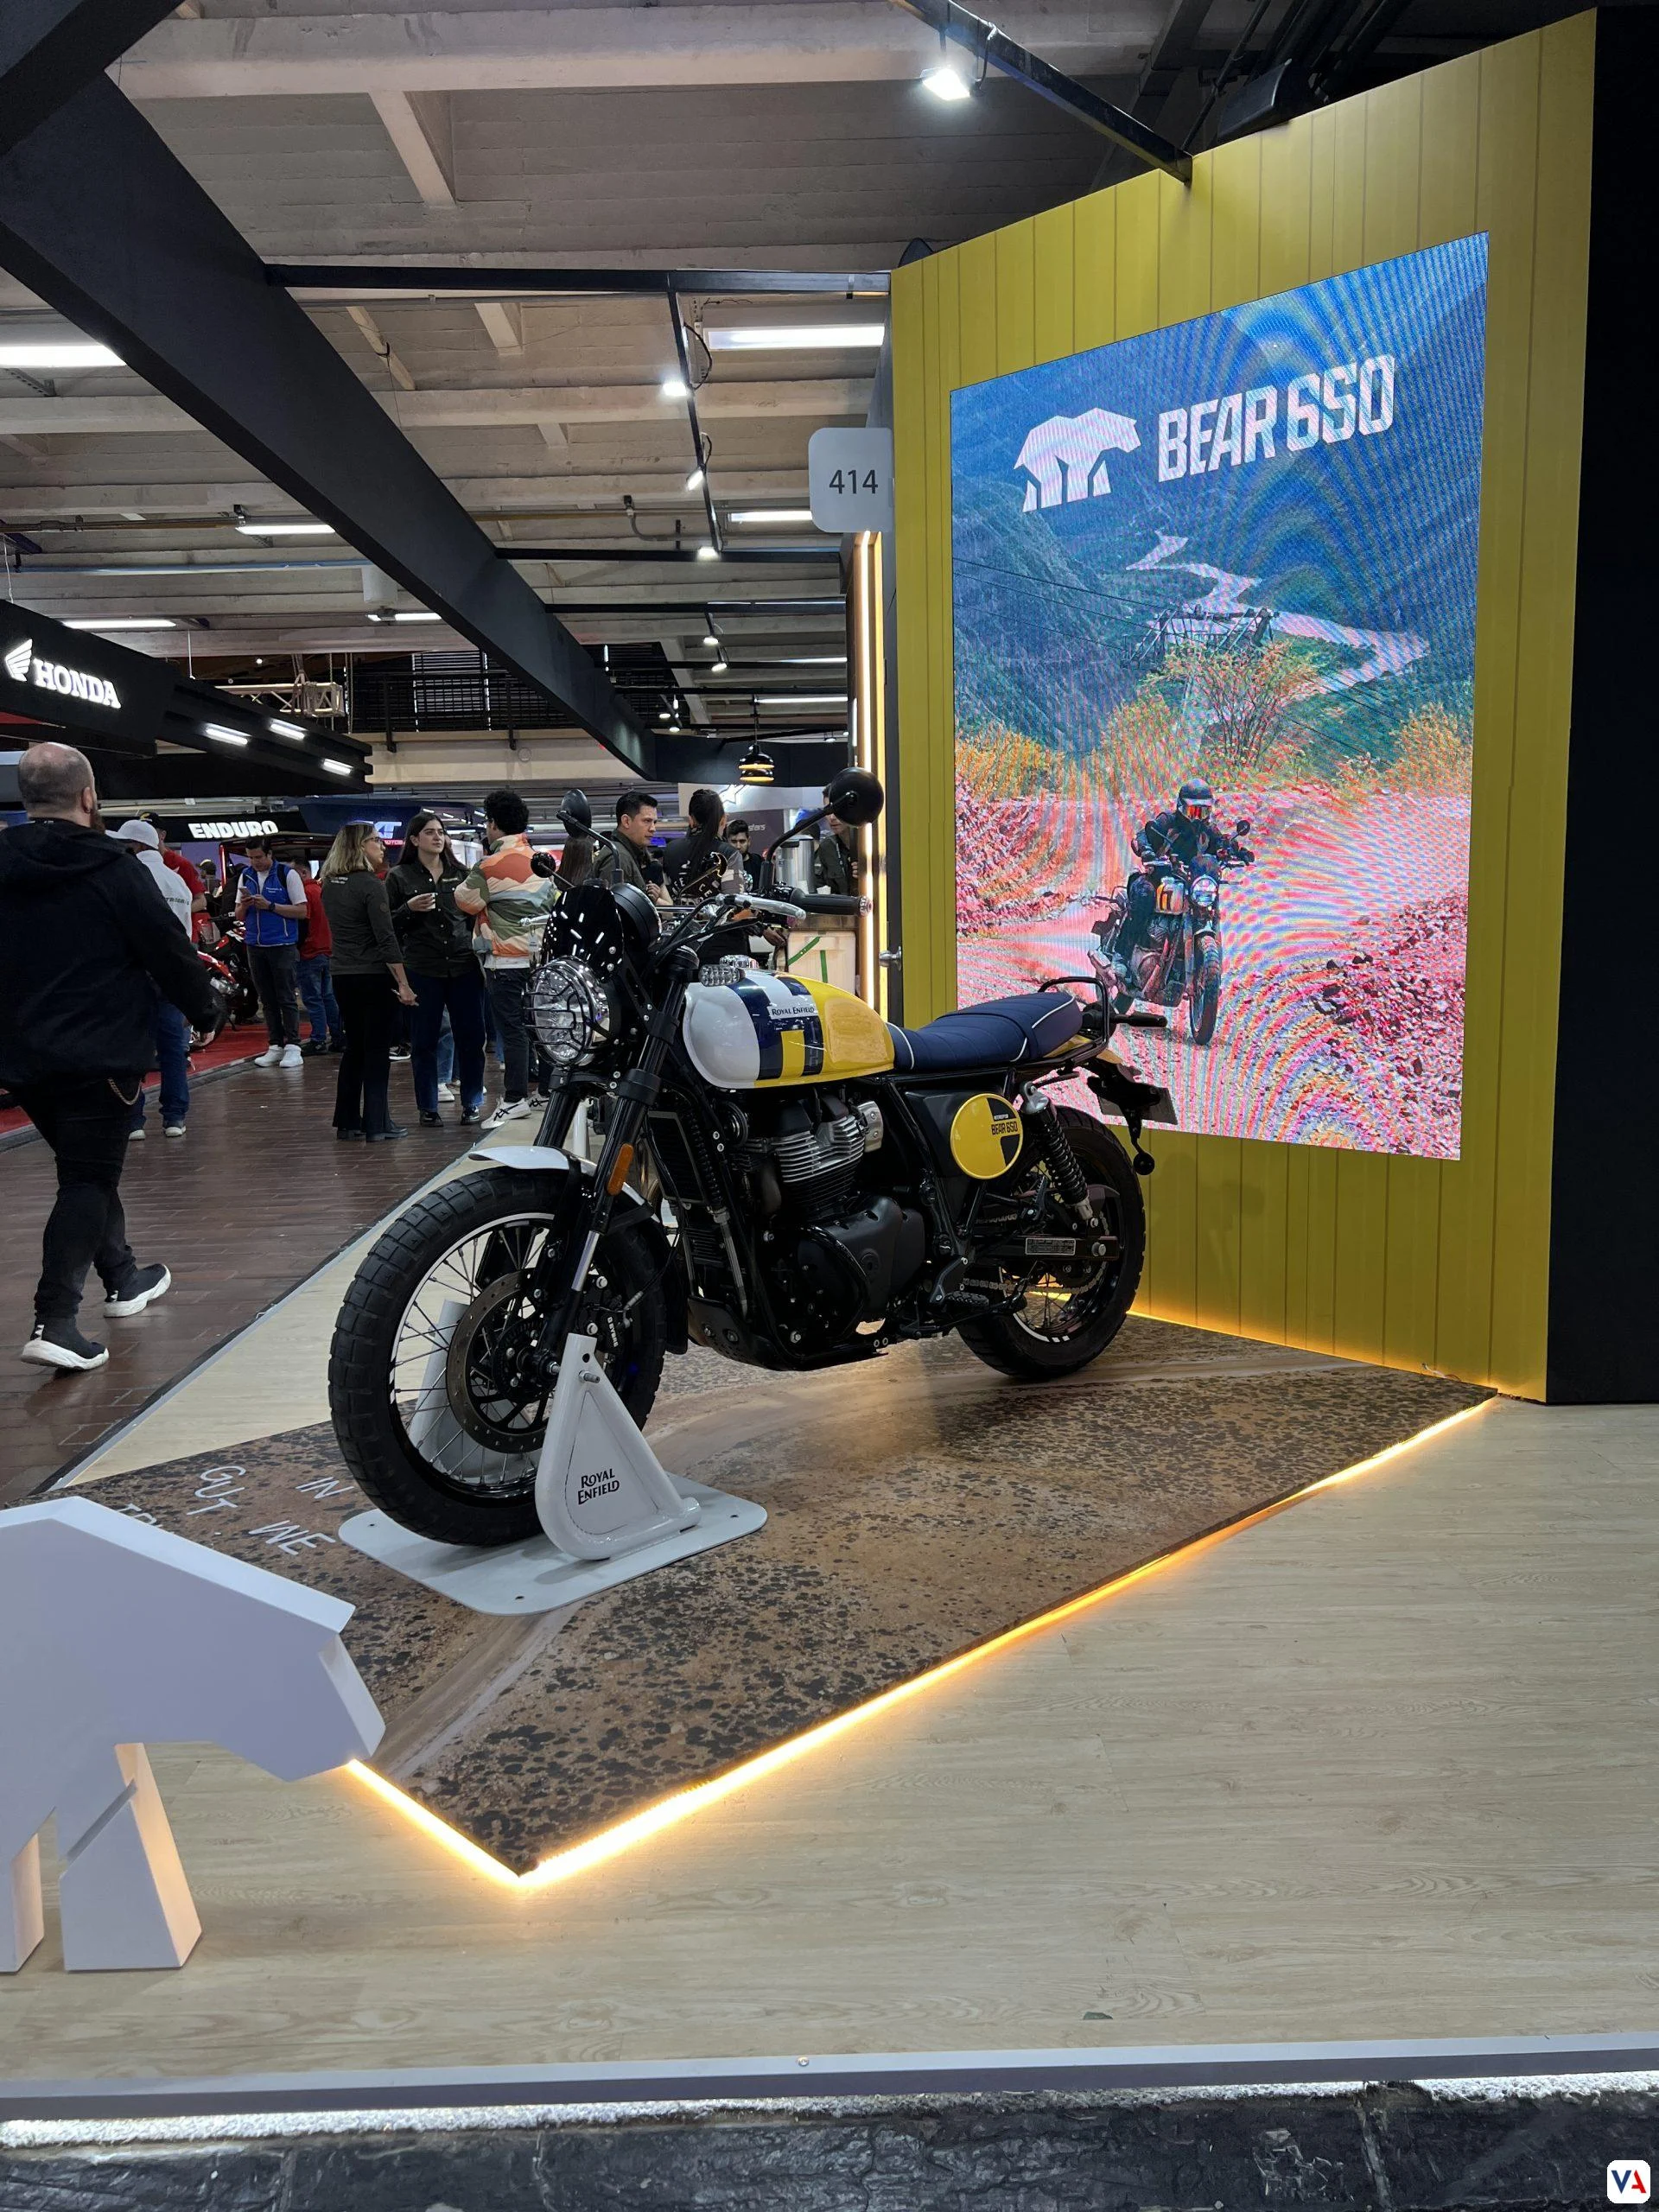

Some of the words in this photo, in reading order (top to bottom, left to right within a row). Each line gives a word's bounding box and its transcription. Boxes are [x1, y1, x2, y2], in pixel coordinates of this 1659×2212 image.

[1158, 385, 1278, 483] BEAR
[1286, 354, 1395, 452] 650
[829, 469, 879, 494] 414
[32, 658, 122, 709] HONDA
[188, 820, 280, 839] ENDURO
[772, 1007, 791, 1016] ROYAL
[792, 1006, 815, 1014] ENFIELD
[991, 1122, 1006, 1135] BEAR
[1006, 1121, 1019, 1133] 650
[296, 1477, 354, 1500] IN
[581, 1468, 615, 1489] ROYAL
[577, 1480, 620, 1505] ENFIELD
[248, 1520, 336, 1555] WE
